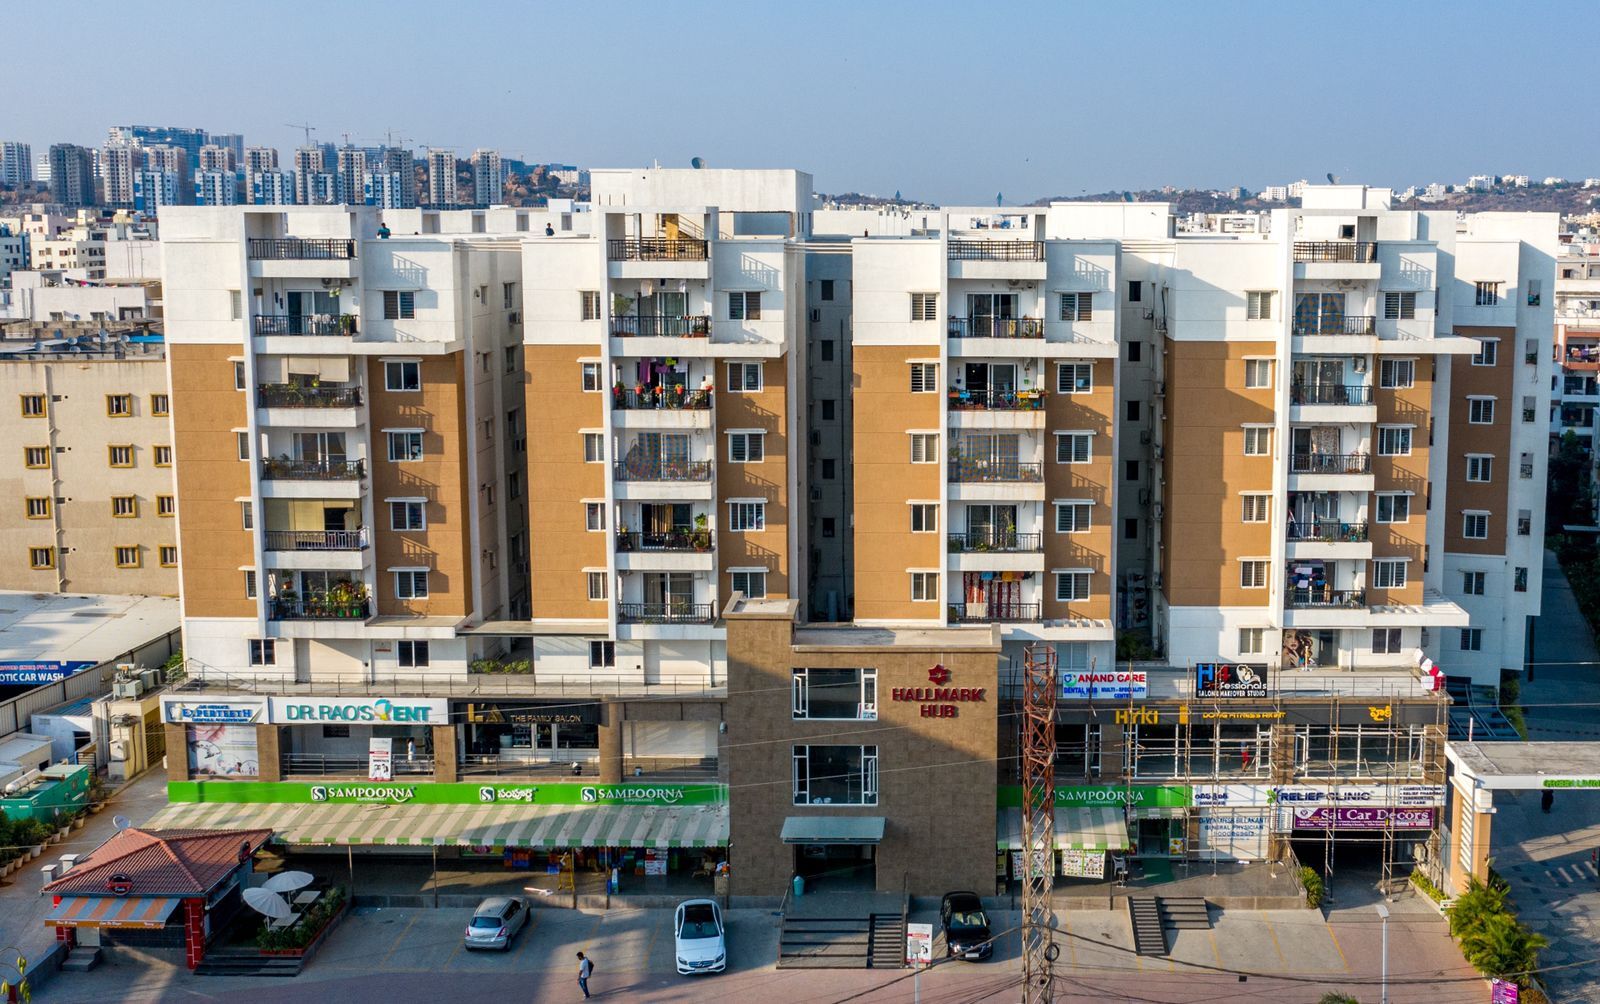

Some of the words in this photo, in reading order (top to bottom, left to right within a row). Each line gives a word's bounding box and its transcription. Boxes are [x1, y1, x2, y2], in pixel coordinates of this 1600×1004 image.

[19, 673, 36, 682] CAR
[37, 673, 64, 682] WASH
[1078, 674, 1114, 682] ANAND
[1117, 674, 1145, 682] CARE
[892, 687, 985, 702] HALLMARK
[393, 706, 433, 722] ENT
[920, 704, 960, 718] HUB
[328, 787, 414, 802] SAMPOORNA
[598, 788, 684, 803] SAMPOORNA
[1058, 790, 1144, 804] SAMPOORNA
[1280, 792, 1324, 801] RELIEF
[1325, 792, 1371, 801] CLINIC
[1321, 810, 1342, 820] Sai
[1346, 810, 1372, 820] Car
[1376, 810, 1429, 820] Decors
